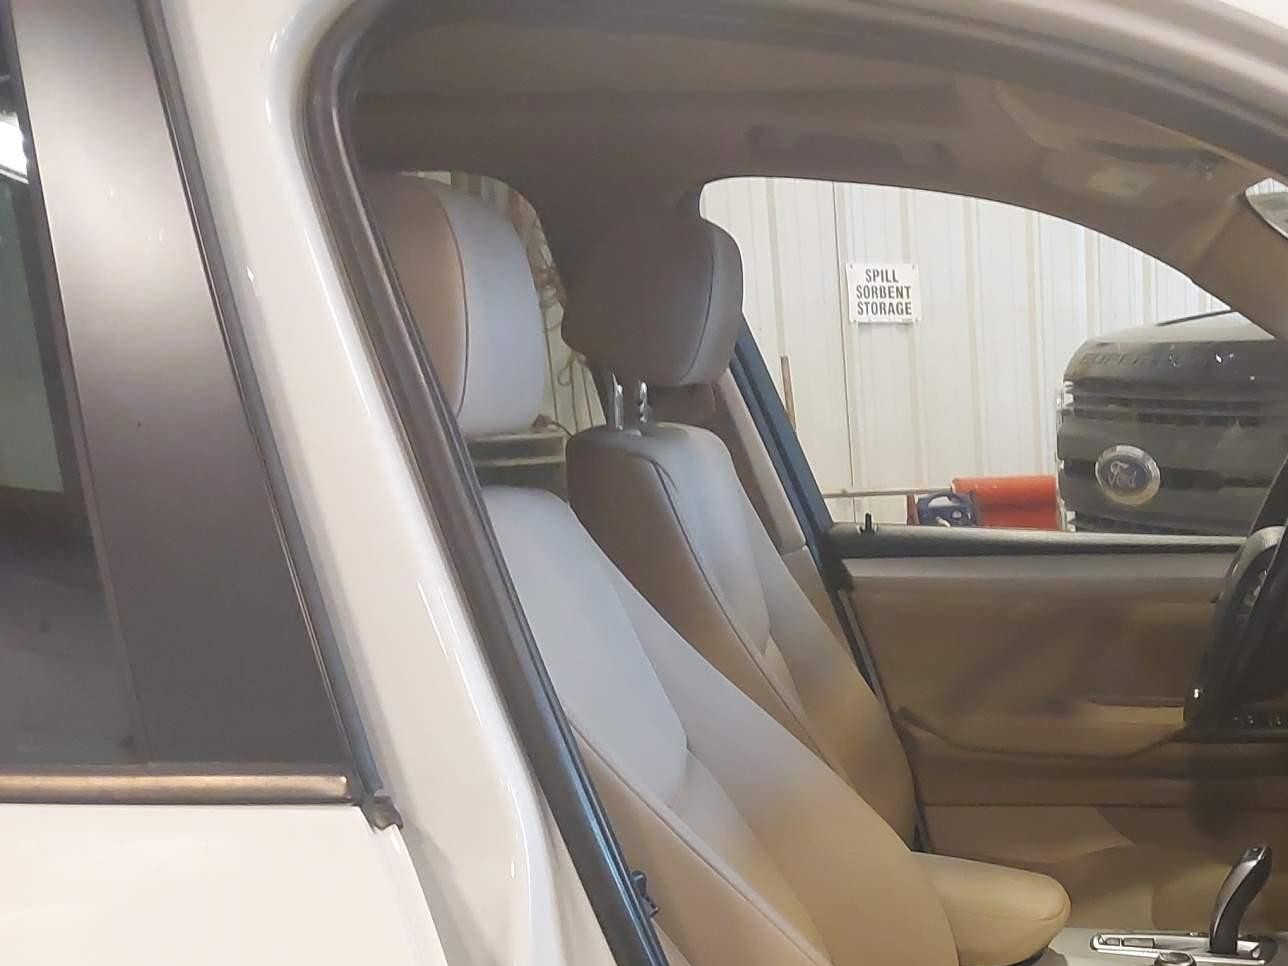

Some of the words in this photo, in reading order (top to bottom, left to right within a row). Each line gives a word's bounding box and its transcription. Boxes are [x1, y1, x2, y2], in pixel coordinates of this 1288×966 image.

[865, 268, 899, 283] SPILL
[856, 284, 912, 300] SORBENT
[857, 301, 912, 316] STORAGE
